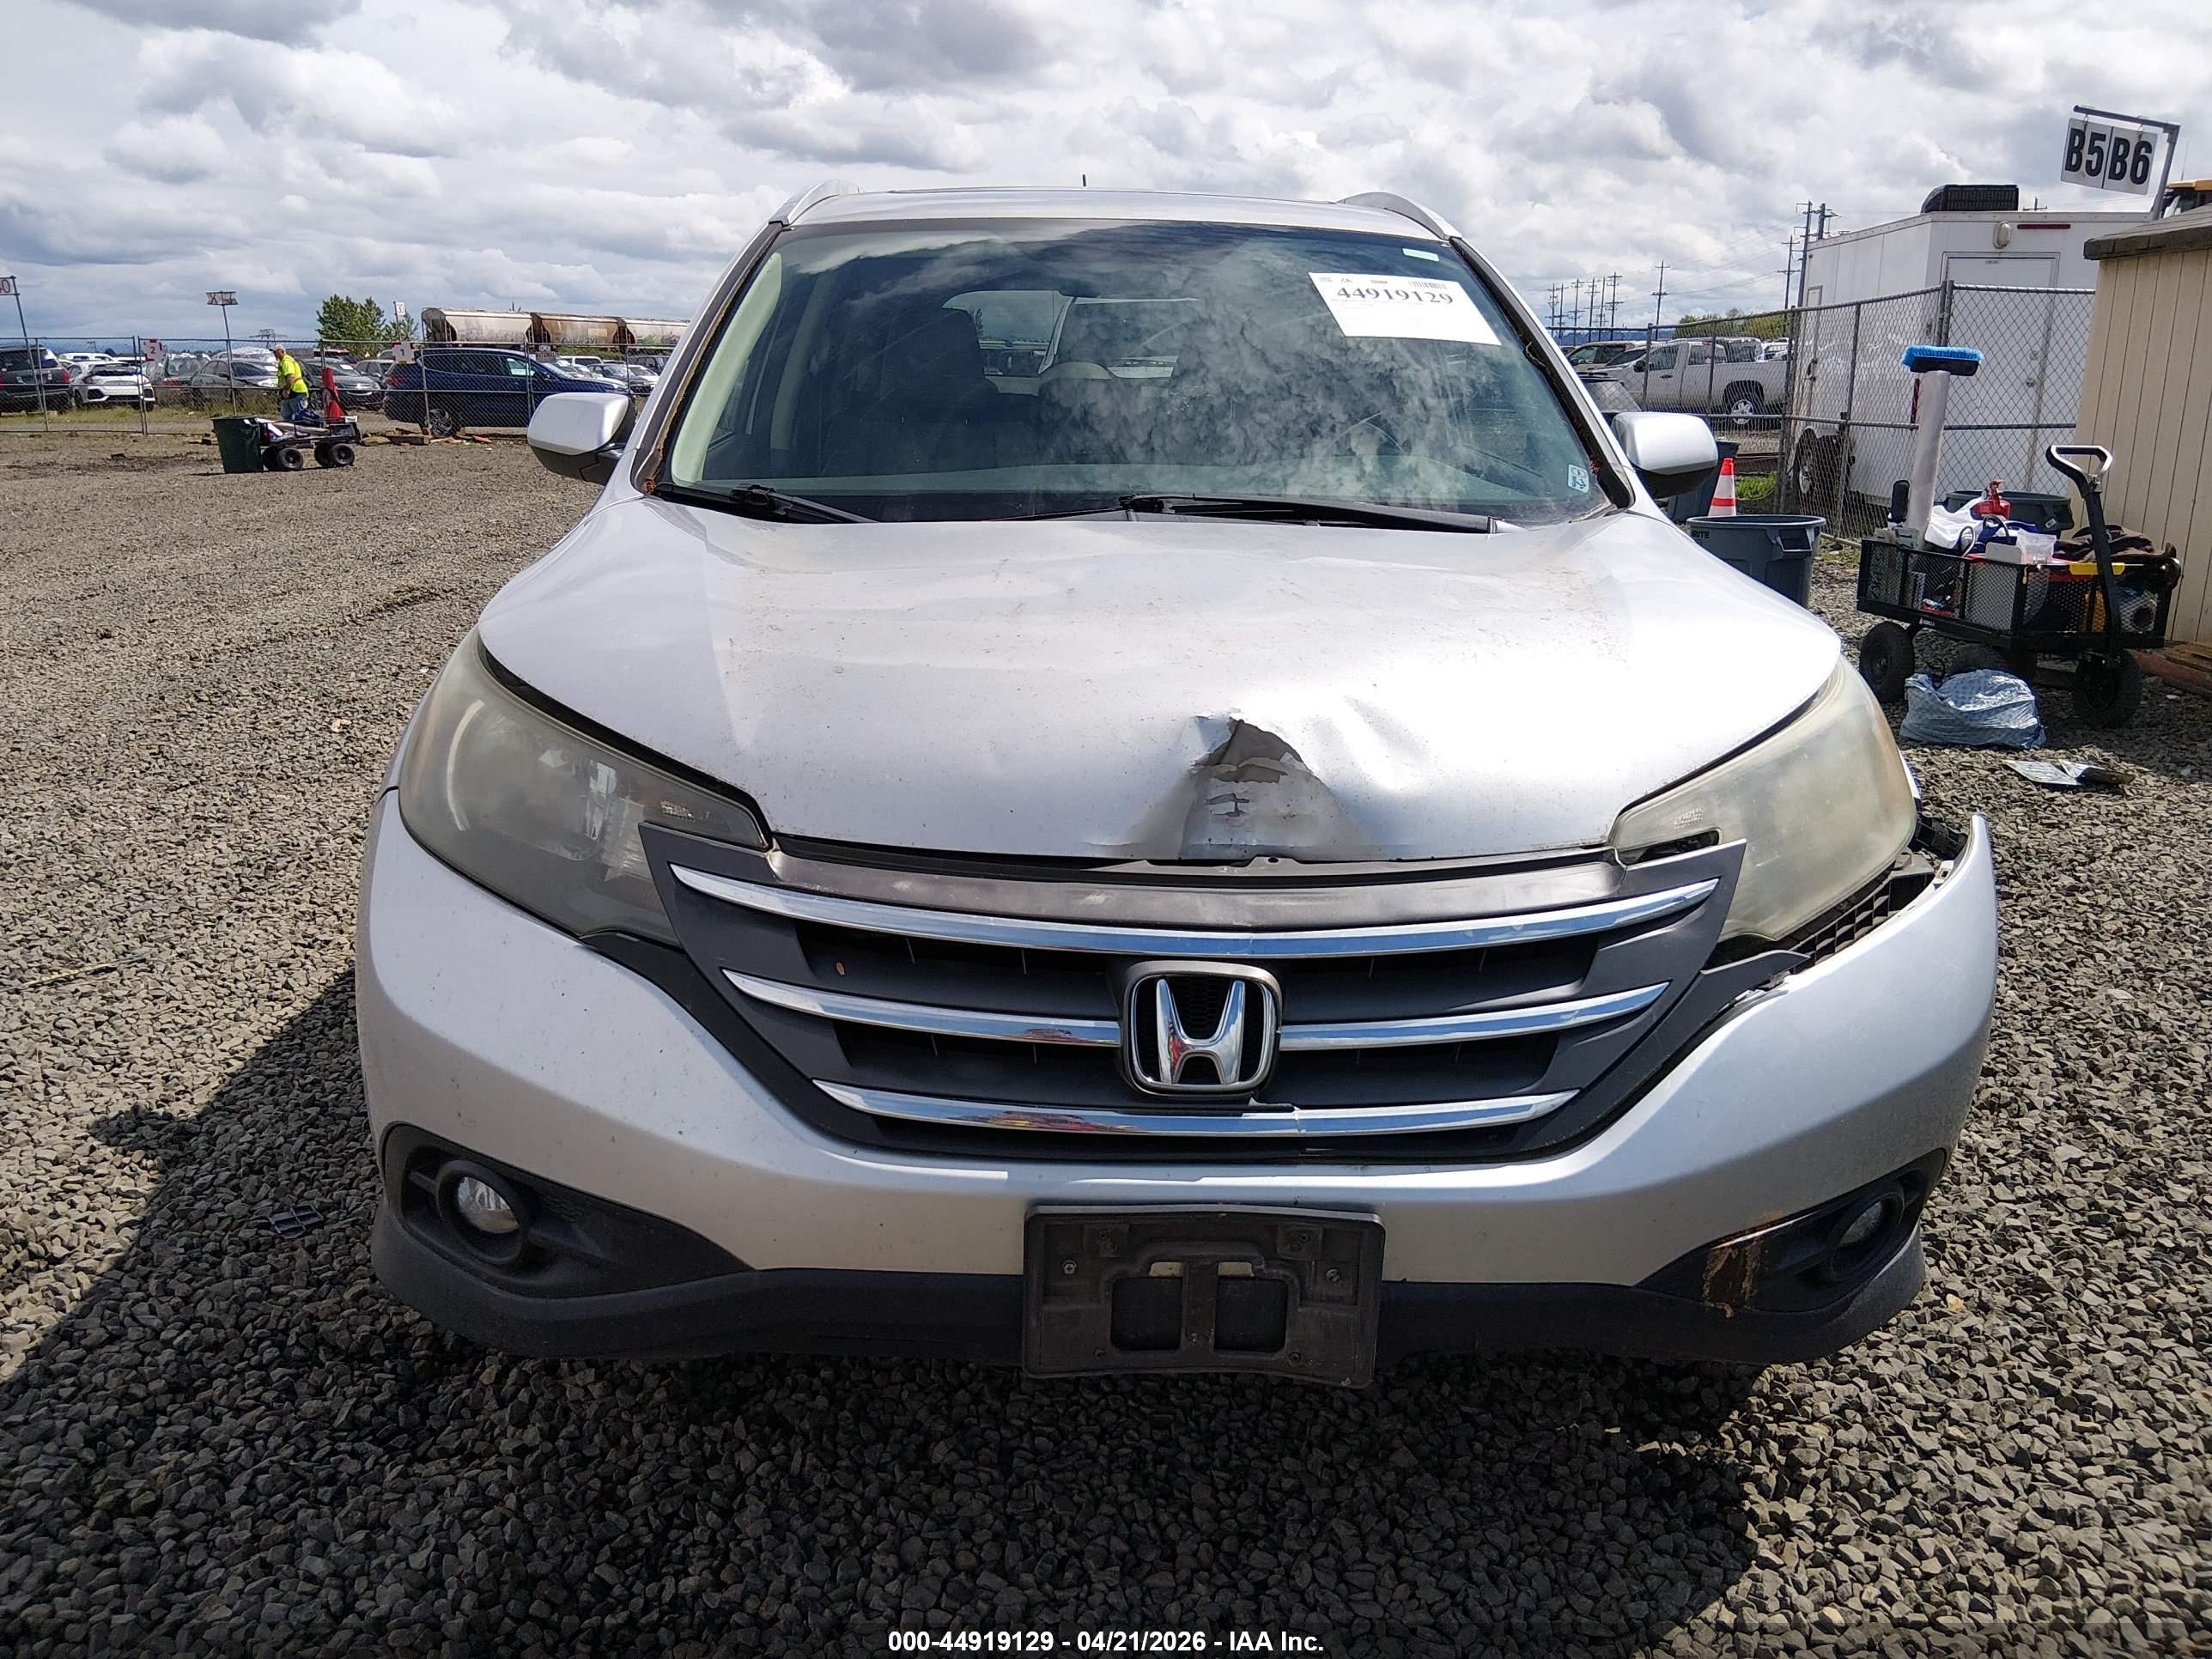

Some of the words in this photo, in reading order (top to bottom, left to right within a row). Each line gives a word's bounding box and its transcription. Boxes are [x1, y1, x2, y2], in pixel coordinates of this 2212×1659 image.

[0, 278, 10, 294] 0
[1337, 287, 1454, 304] 44919129
[399, 348, 404, 356] 1
